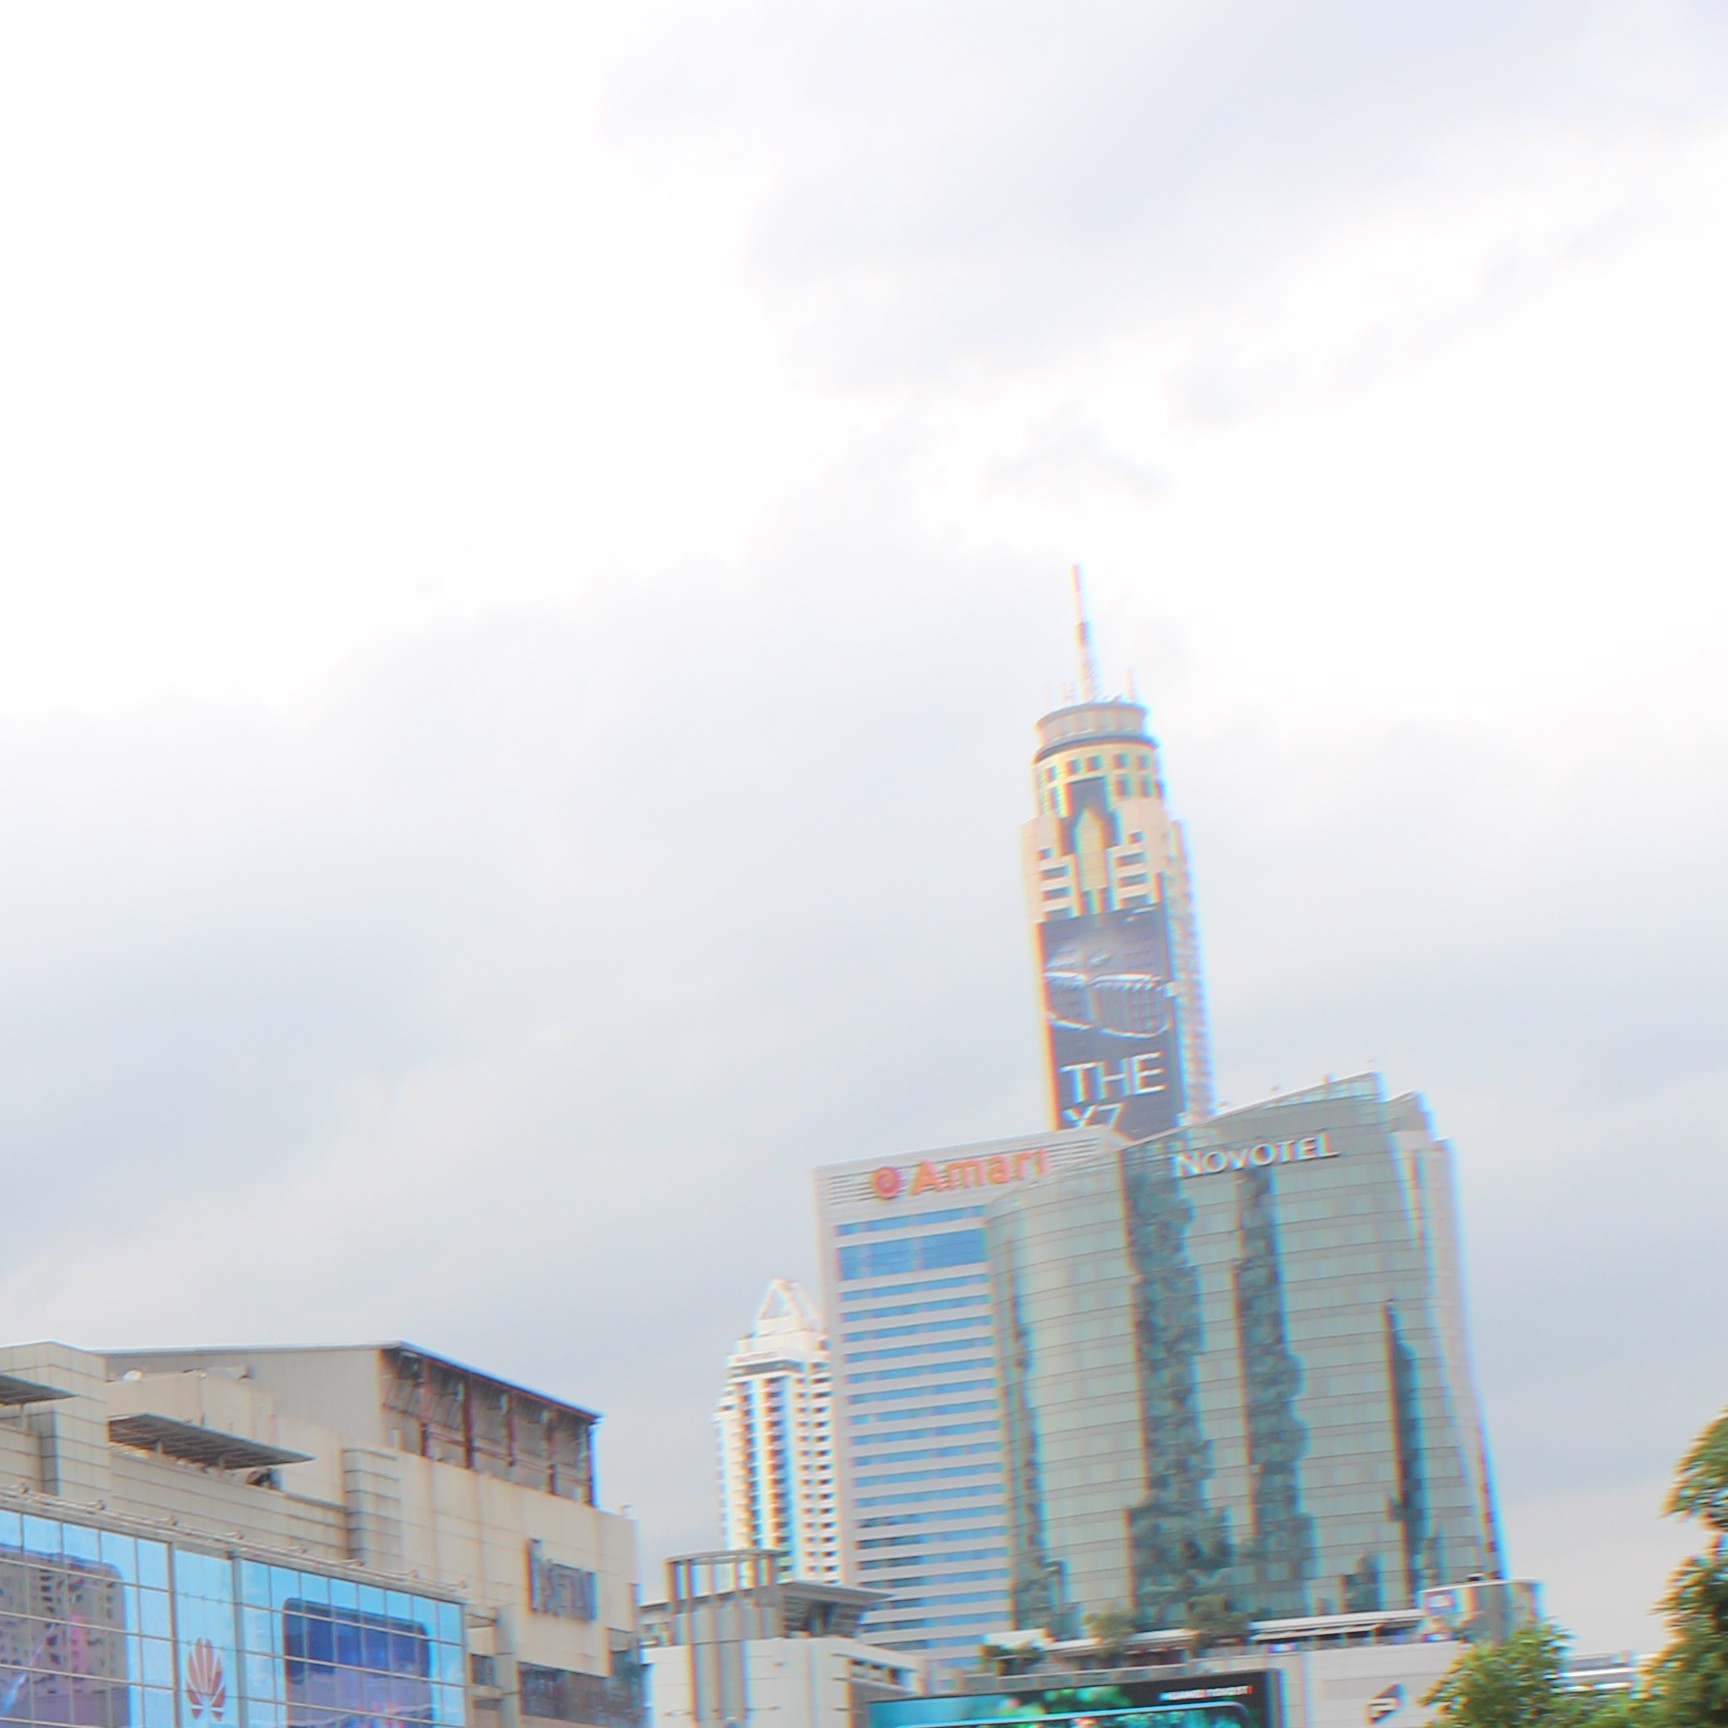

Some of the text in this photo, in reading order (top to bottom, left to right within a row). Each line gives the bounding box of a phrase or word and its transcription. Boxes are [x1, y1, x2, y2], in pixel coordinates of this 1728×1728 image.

[1059, 1050, 1168, 1103] THE
[909, 1149, 1048, 1196] Amari
[1174, 1130, 1341, 1179] NOVOTEL
